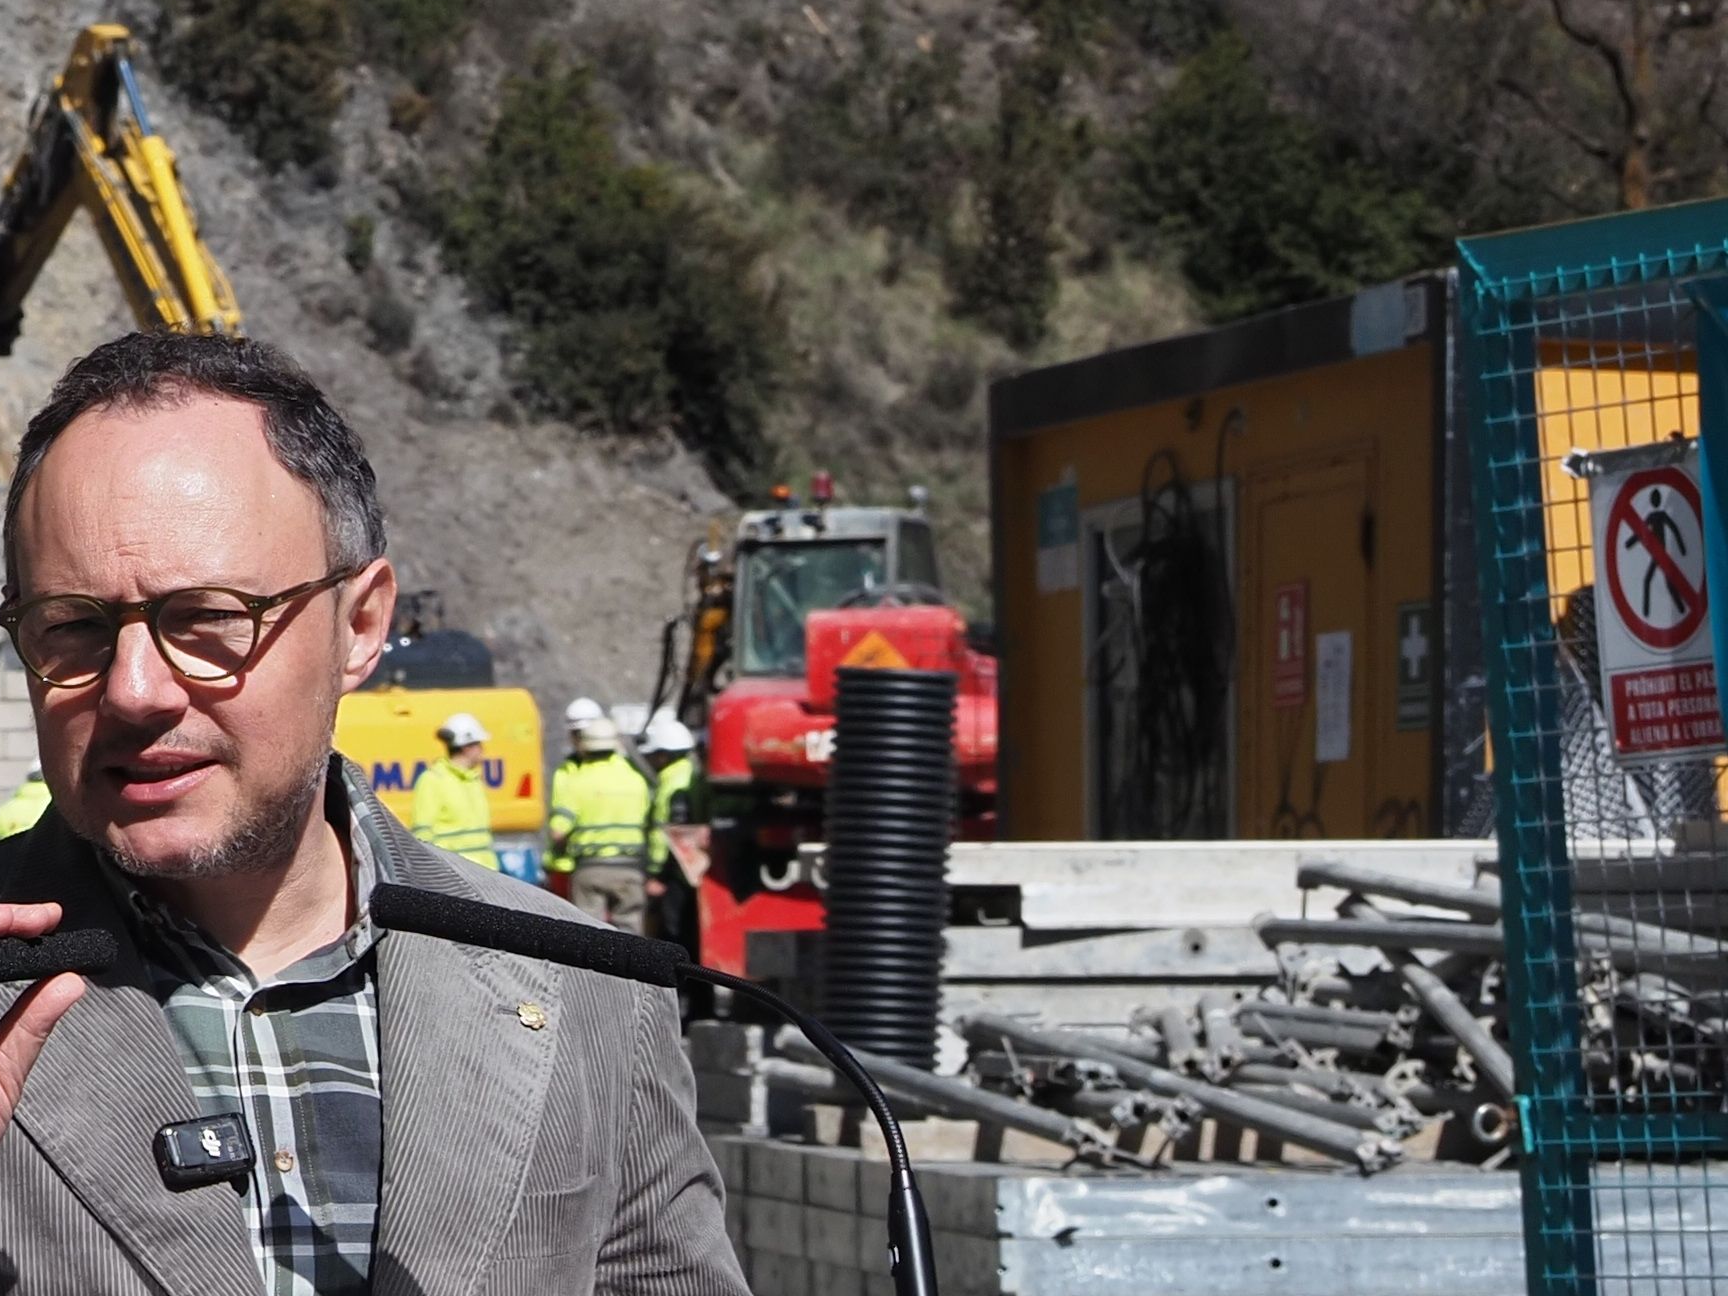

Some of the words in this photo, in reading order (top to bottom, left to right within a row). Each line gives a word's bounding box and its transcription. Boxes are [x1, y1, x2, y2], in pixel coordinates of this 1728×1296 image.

[1679, 672, 1693, 691] EL
[1627, 703, 1637, 721] A
[1637, 700, 1665, 720] TOTA
[1630, 724, 1669, 744] ALIENA
[1672, 723, 1681, 740] A
